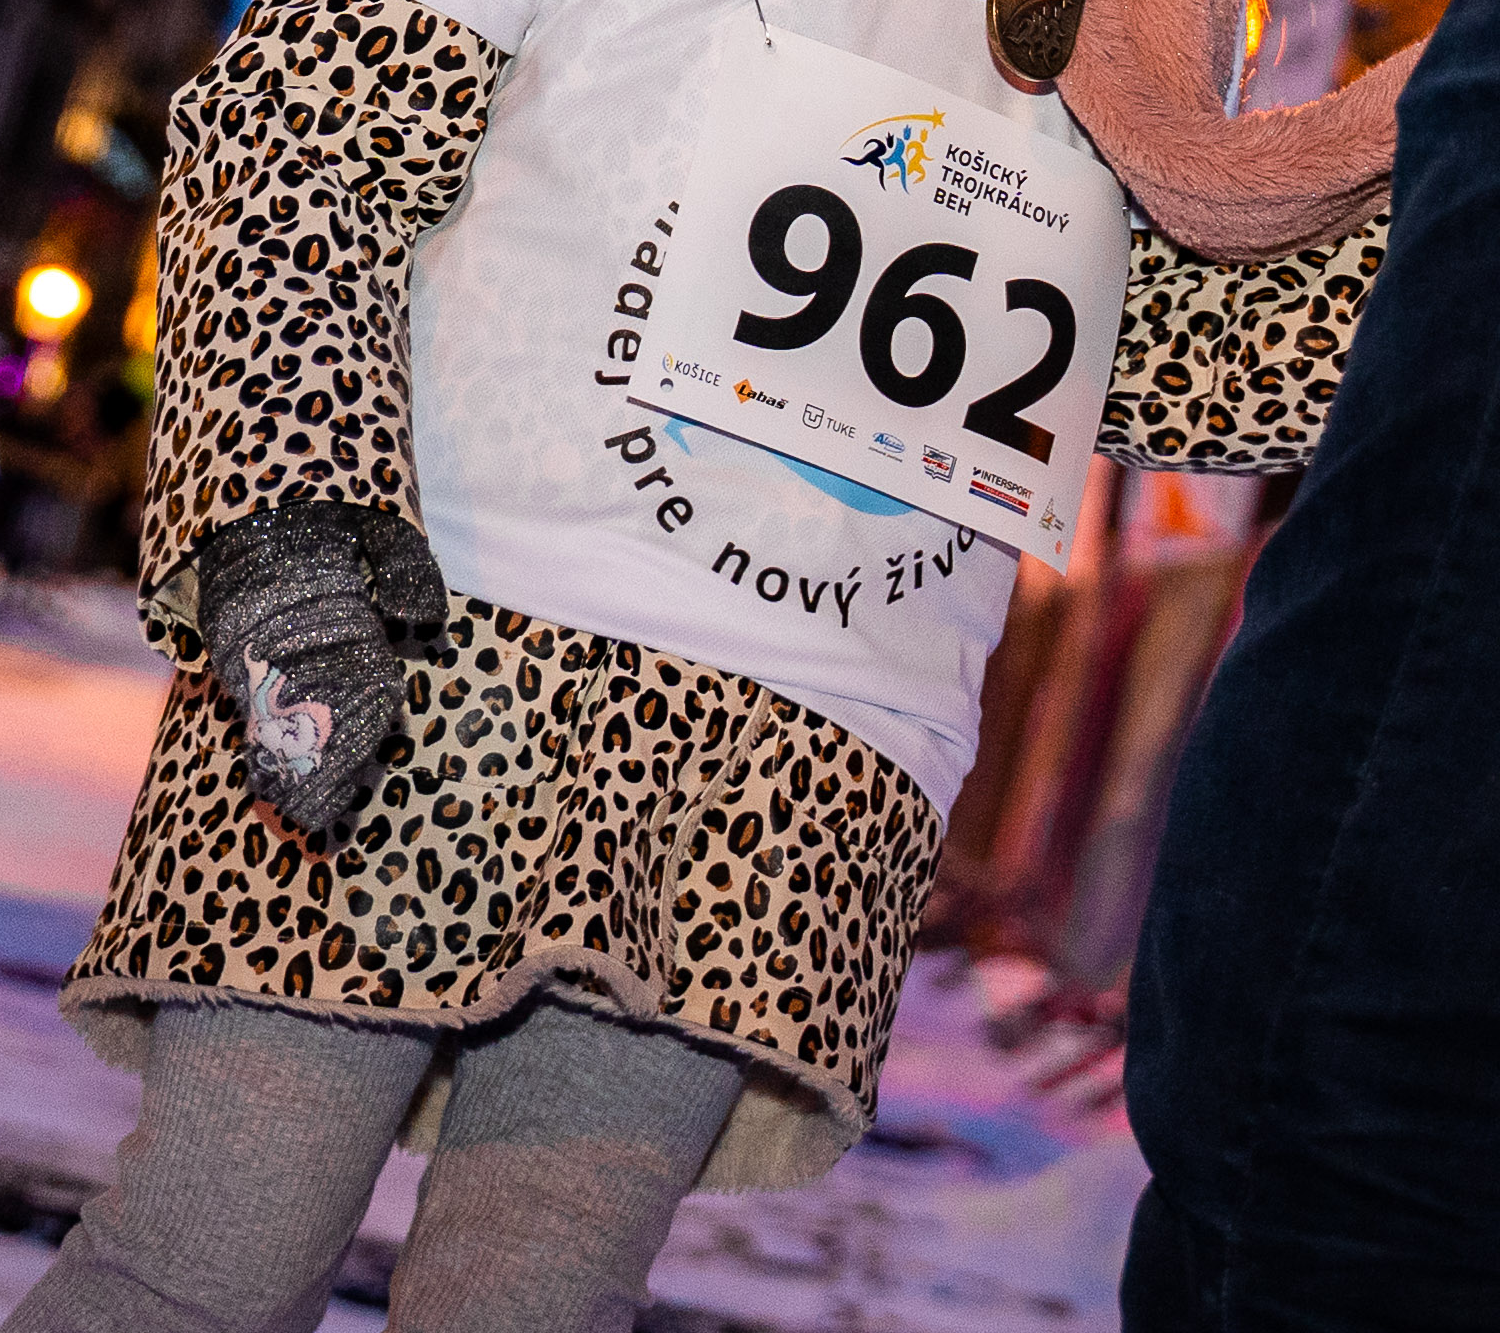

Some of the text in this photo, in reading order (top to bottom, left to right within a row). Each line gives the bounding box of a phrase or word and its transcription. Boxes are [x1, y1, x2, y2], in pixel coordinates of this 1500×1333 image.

[946, 144, 1028, 190] KOŠICKÝ
[933, 188, 972, 216] BEH
[942, 165, 1069, 233] TROJKRÁĽOVÝ
[734, 184, 1076, 465] 962
[674, 360, 722, 387] KOŠICE
[738, 384, 789, 410] Labaš
[826, 417, 857, 439] TUKE
[980, 470, 1035, 500] INTERSPORT
[604, 426, 694, 533] pre
[711, 541, 862, 629] nový
